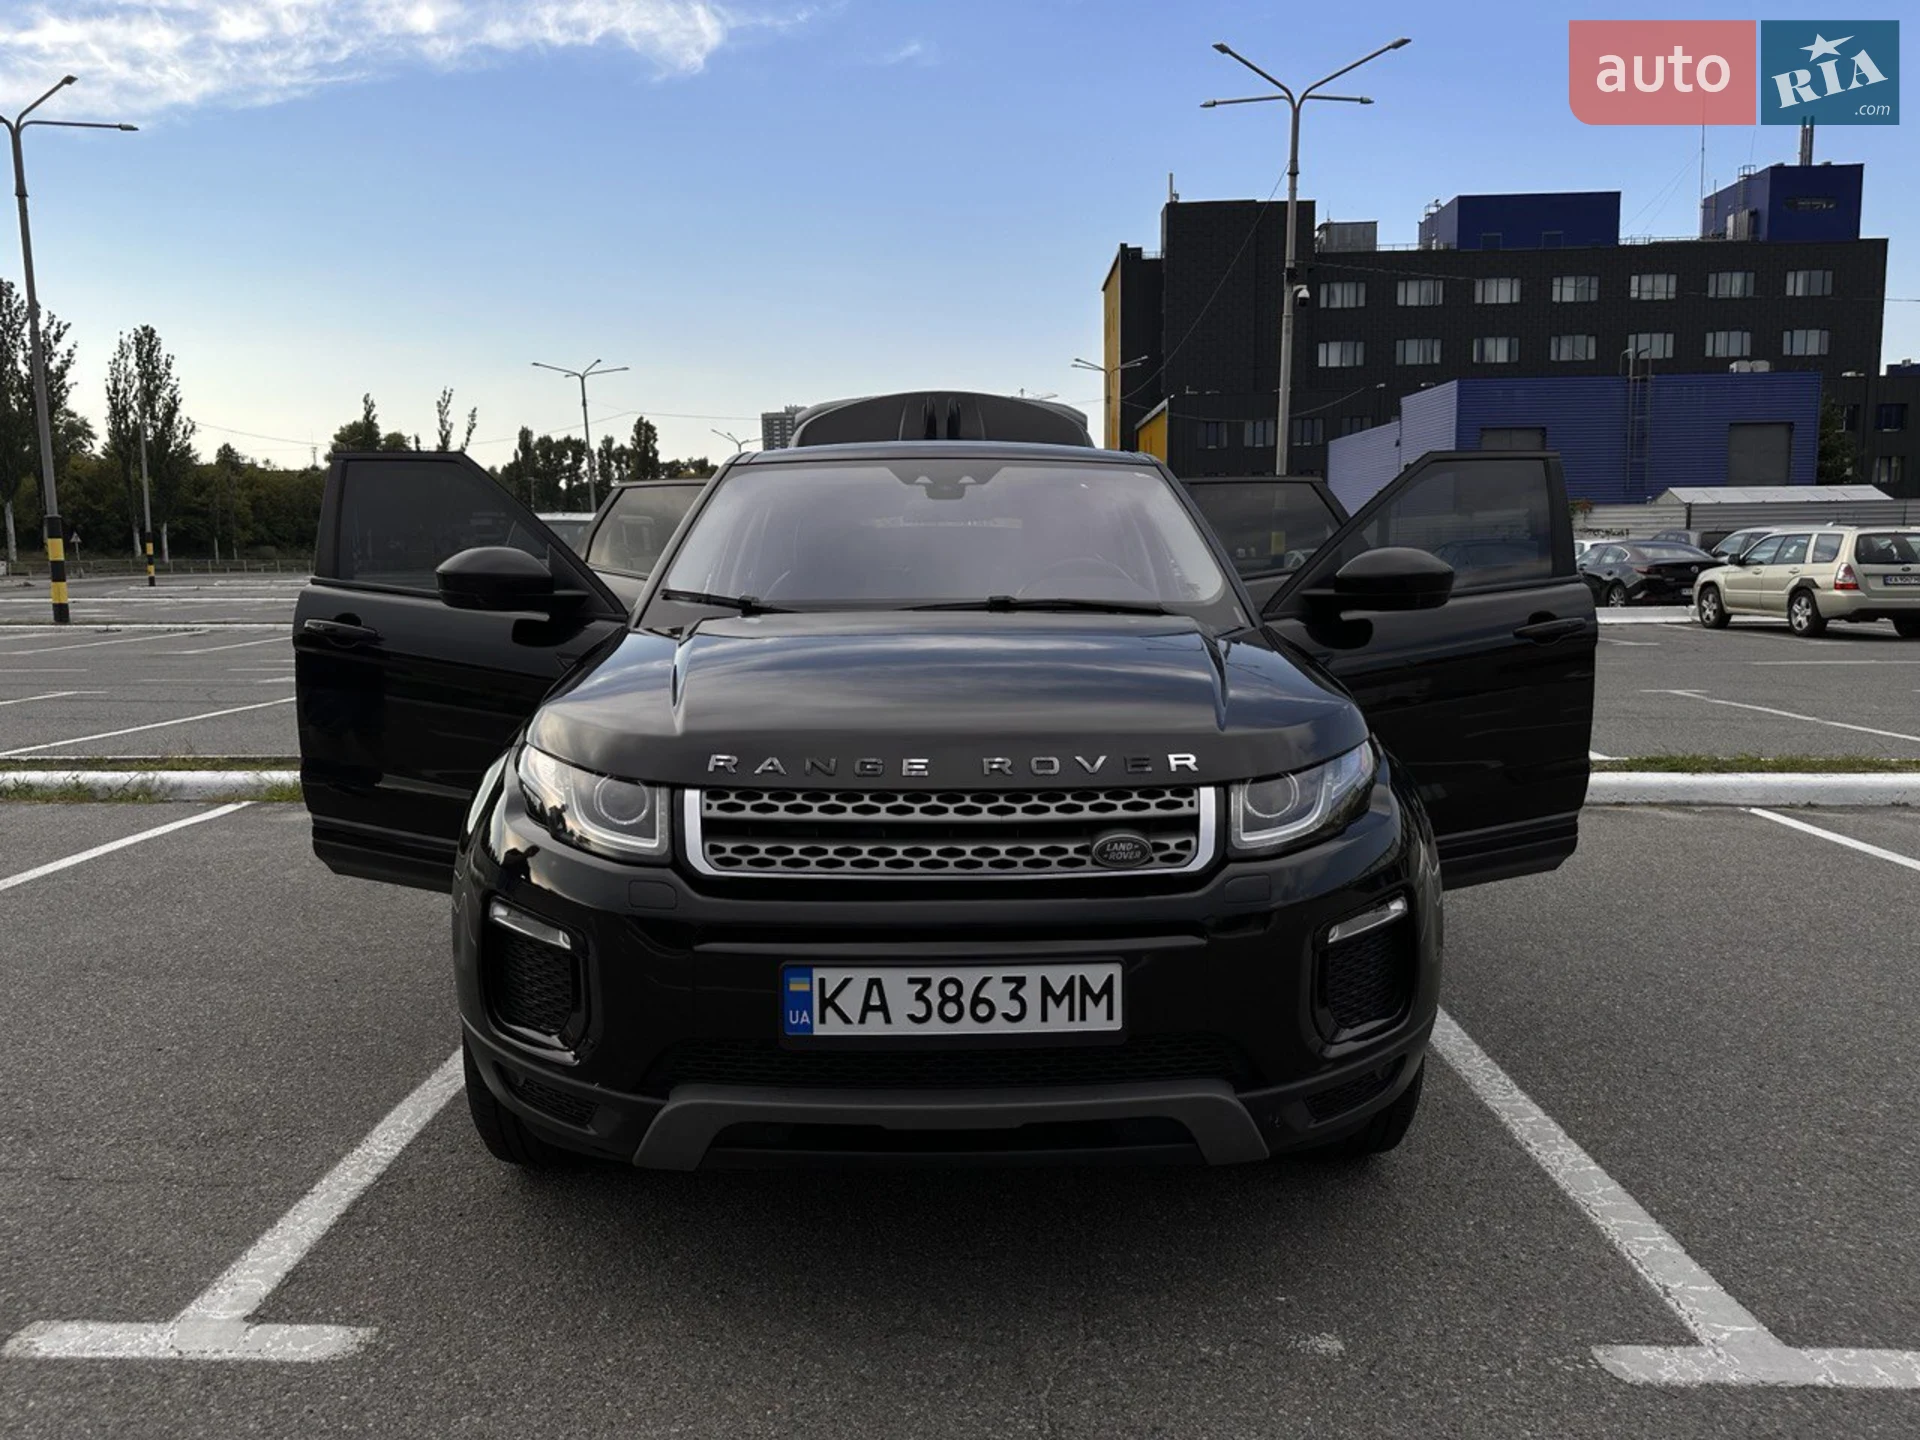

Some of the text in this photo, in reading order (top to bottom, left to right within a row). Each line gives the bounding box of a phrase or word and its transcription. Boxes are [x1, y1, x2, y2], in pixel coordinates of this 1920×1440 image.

[707, 753, 1200, 777] RANGE ROVER
[817, 973, 1115, 1025] KA 3863 MM
[788, 1009, 811, 1026] UA
